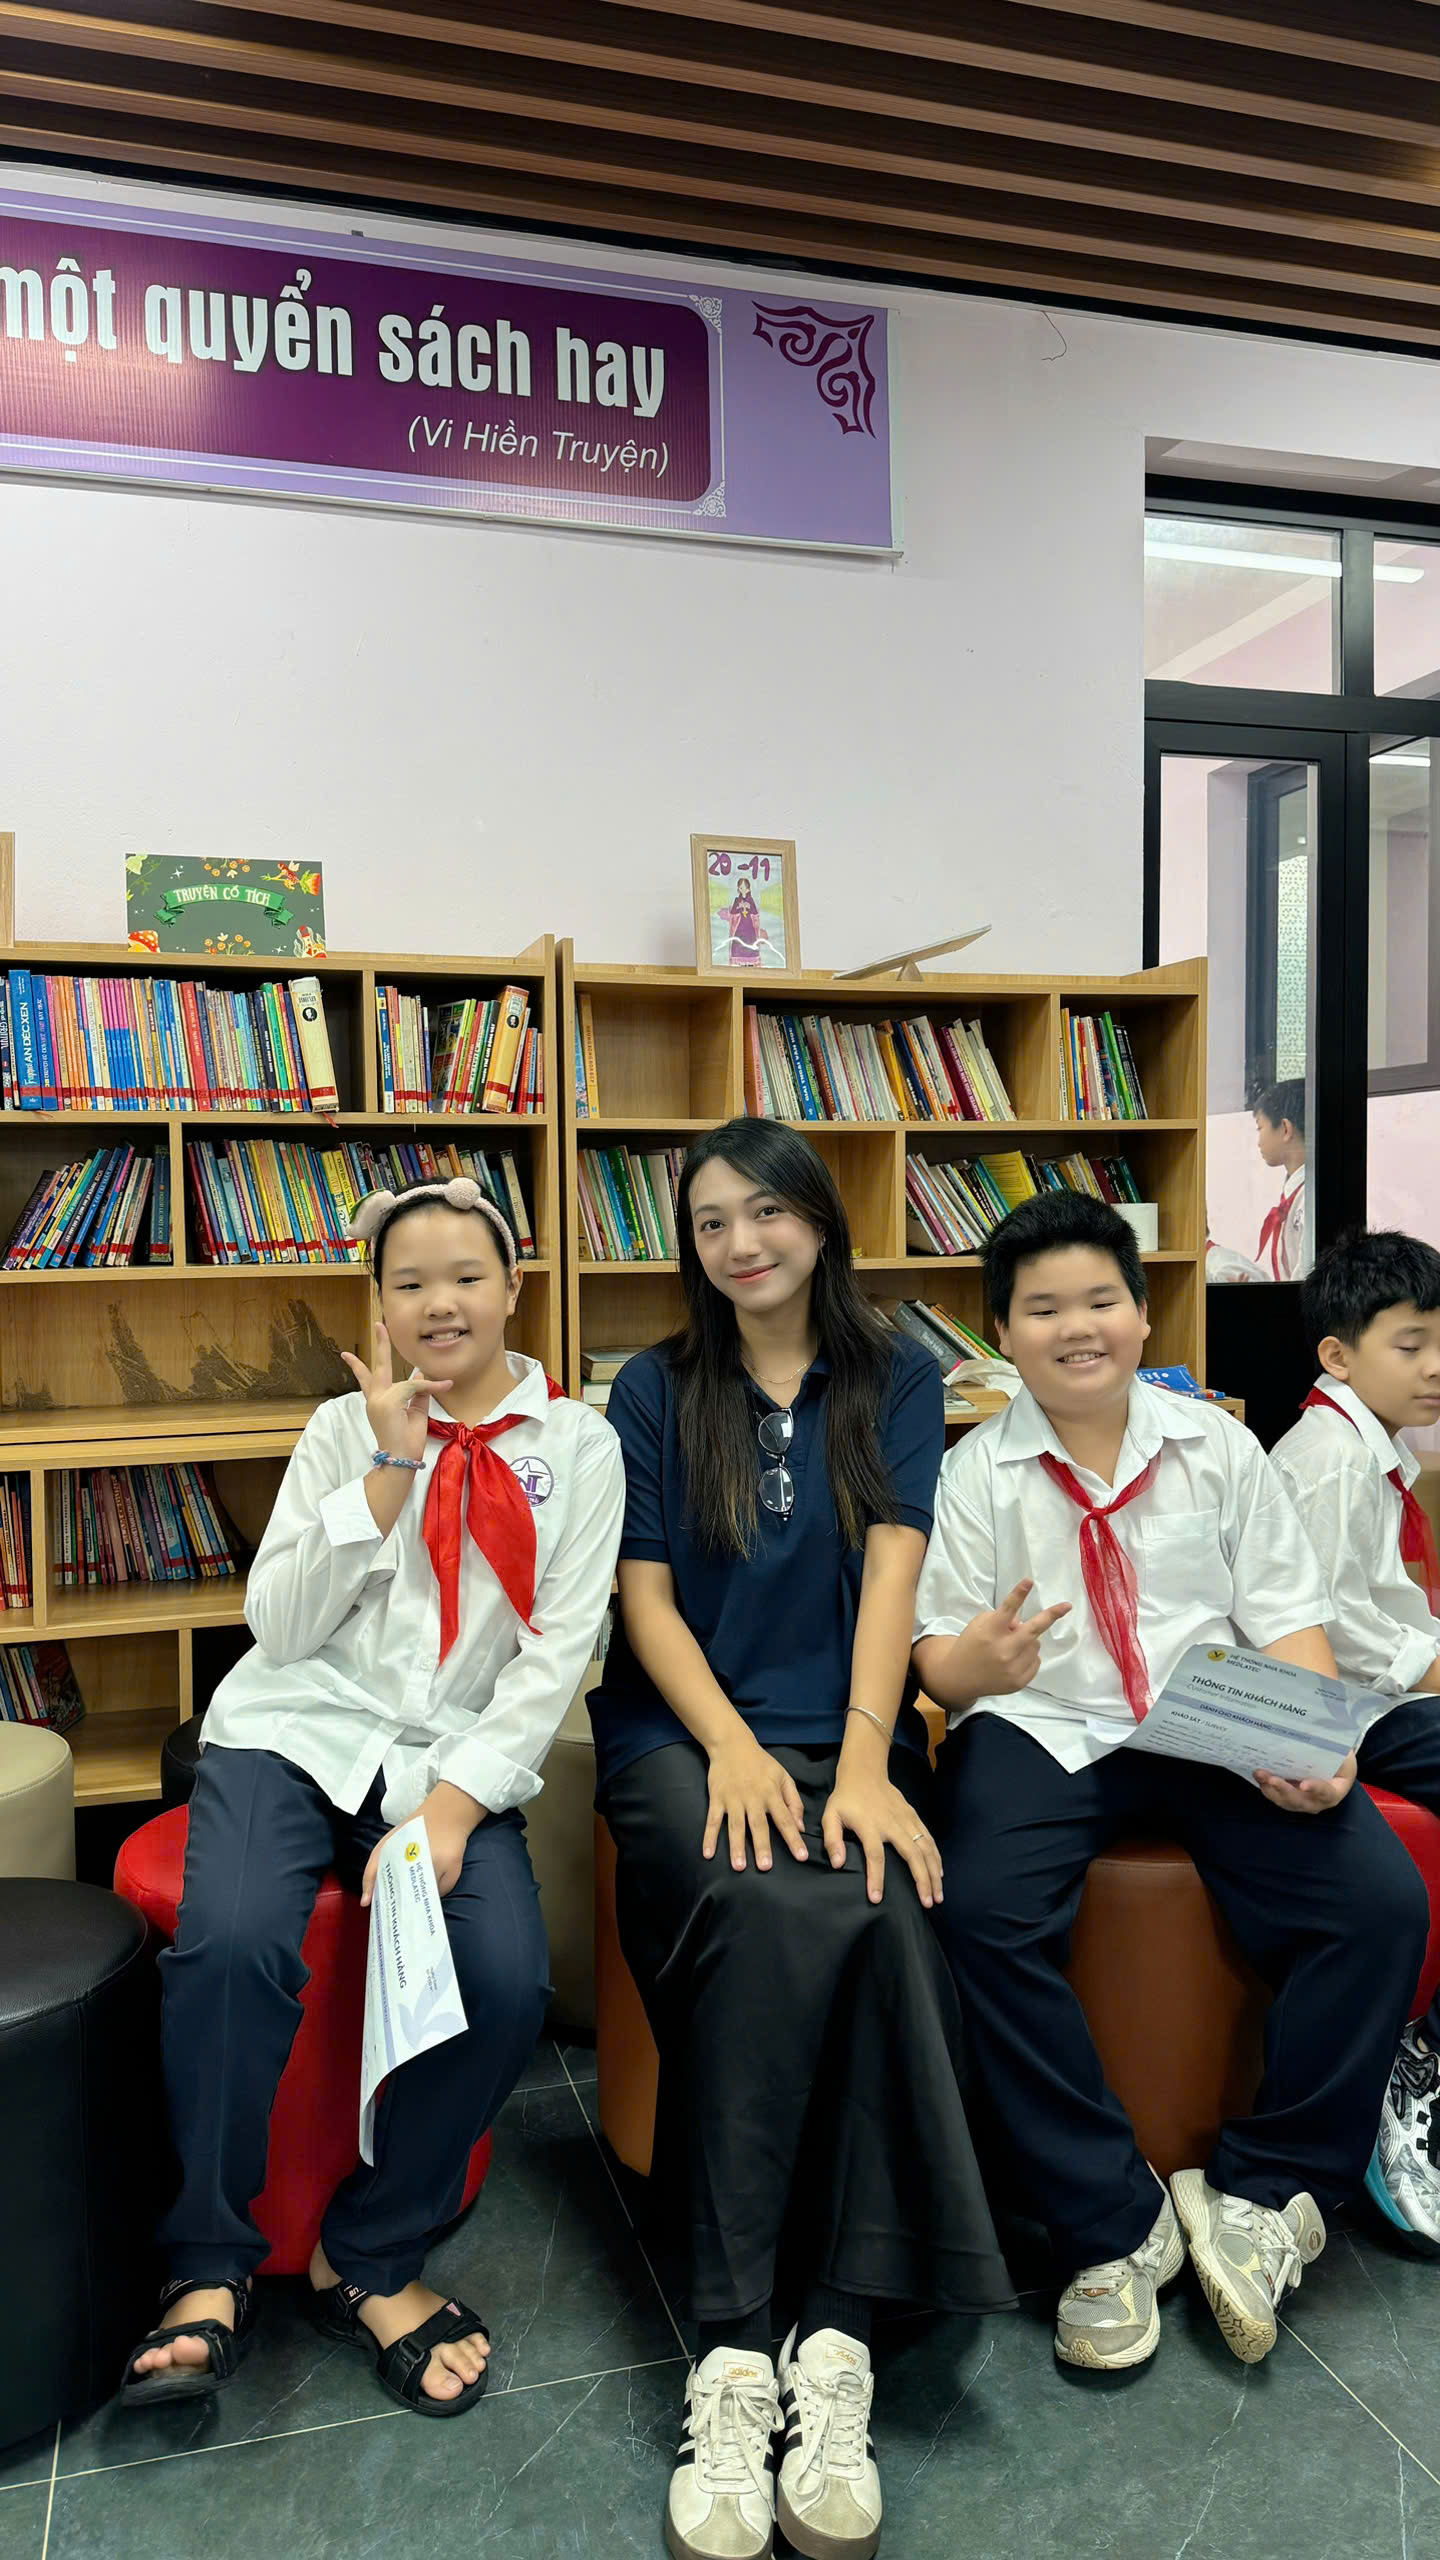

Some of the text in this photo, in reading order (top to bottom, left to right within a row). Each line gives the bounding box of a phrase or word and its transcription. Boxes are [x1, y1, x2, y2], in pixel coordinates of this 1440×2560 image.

[0, 257, 665, 418] một quyển sách hay
[408, 415, 669, 478] (Vi Hiền Truyện)
[172, 884, 218, 903] TRUYỆN
[245, 888, 271, 906] TÍCH
[1191, 1674, 1308, 1717] THÔNG TIN KHÁCH HÀNG
[418, 1871, 429, 1897] THỐNG
[389, 1899, 397, 1917] TIN
[424, 1897, 432, 1916] NHA
[391, 1918, 402, 1955] KHÁCH
[427, 1914, 436, 1936] KHOA
[396, 1956, 408, 1989] HÀNG
